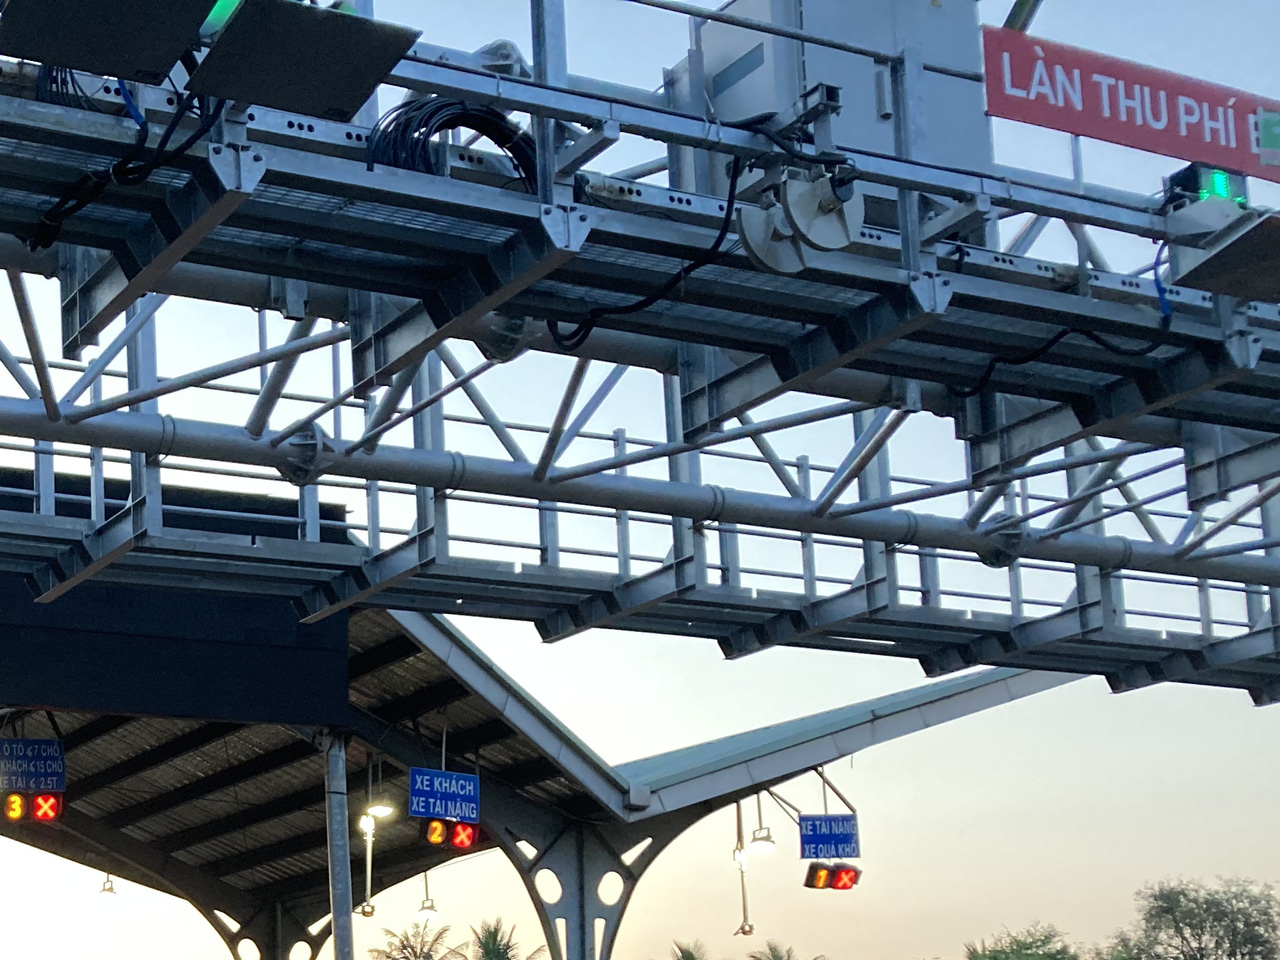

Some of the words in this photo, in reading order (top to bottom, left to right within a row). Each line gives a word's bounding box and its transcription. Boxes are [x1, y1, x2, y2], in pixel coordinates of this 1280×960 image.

[1001, 46, 1083, 111] LÀN
[1092, 74, 1168, 130] THU
[1178, 97, 1237, 148] PHÍ
[1, 758, 28, 772] KHÁCH
[415, 775, 430, 790] XE
[434, 775, 474, 796] KHÁCH
[9, 795, 21, 818] 3
[412, 796, 425, 812] XE
[428, 793, 445, 815] TẢI
[447, 798, 477, 820] NẶNG
[430, 821, 442, 842] 2
[801, 821, 813, 835] XE
[815, 817, 830, 834] TẢI
[805, 844, 816, 857] XE
[818, 841, 836, 858] QUÁ
